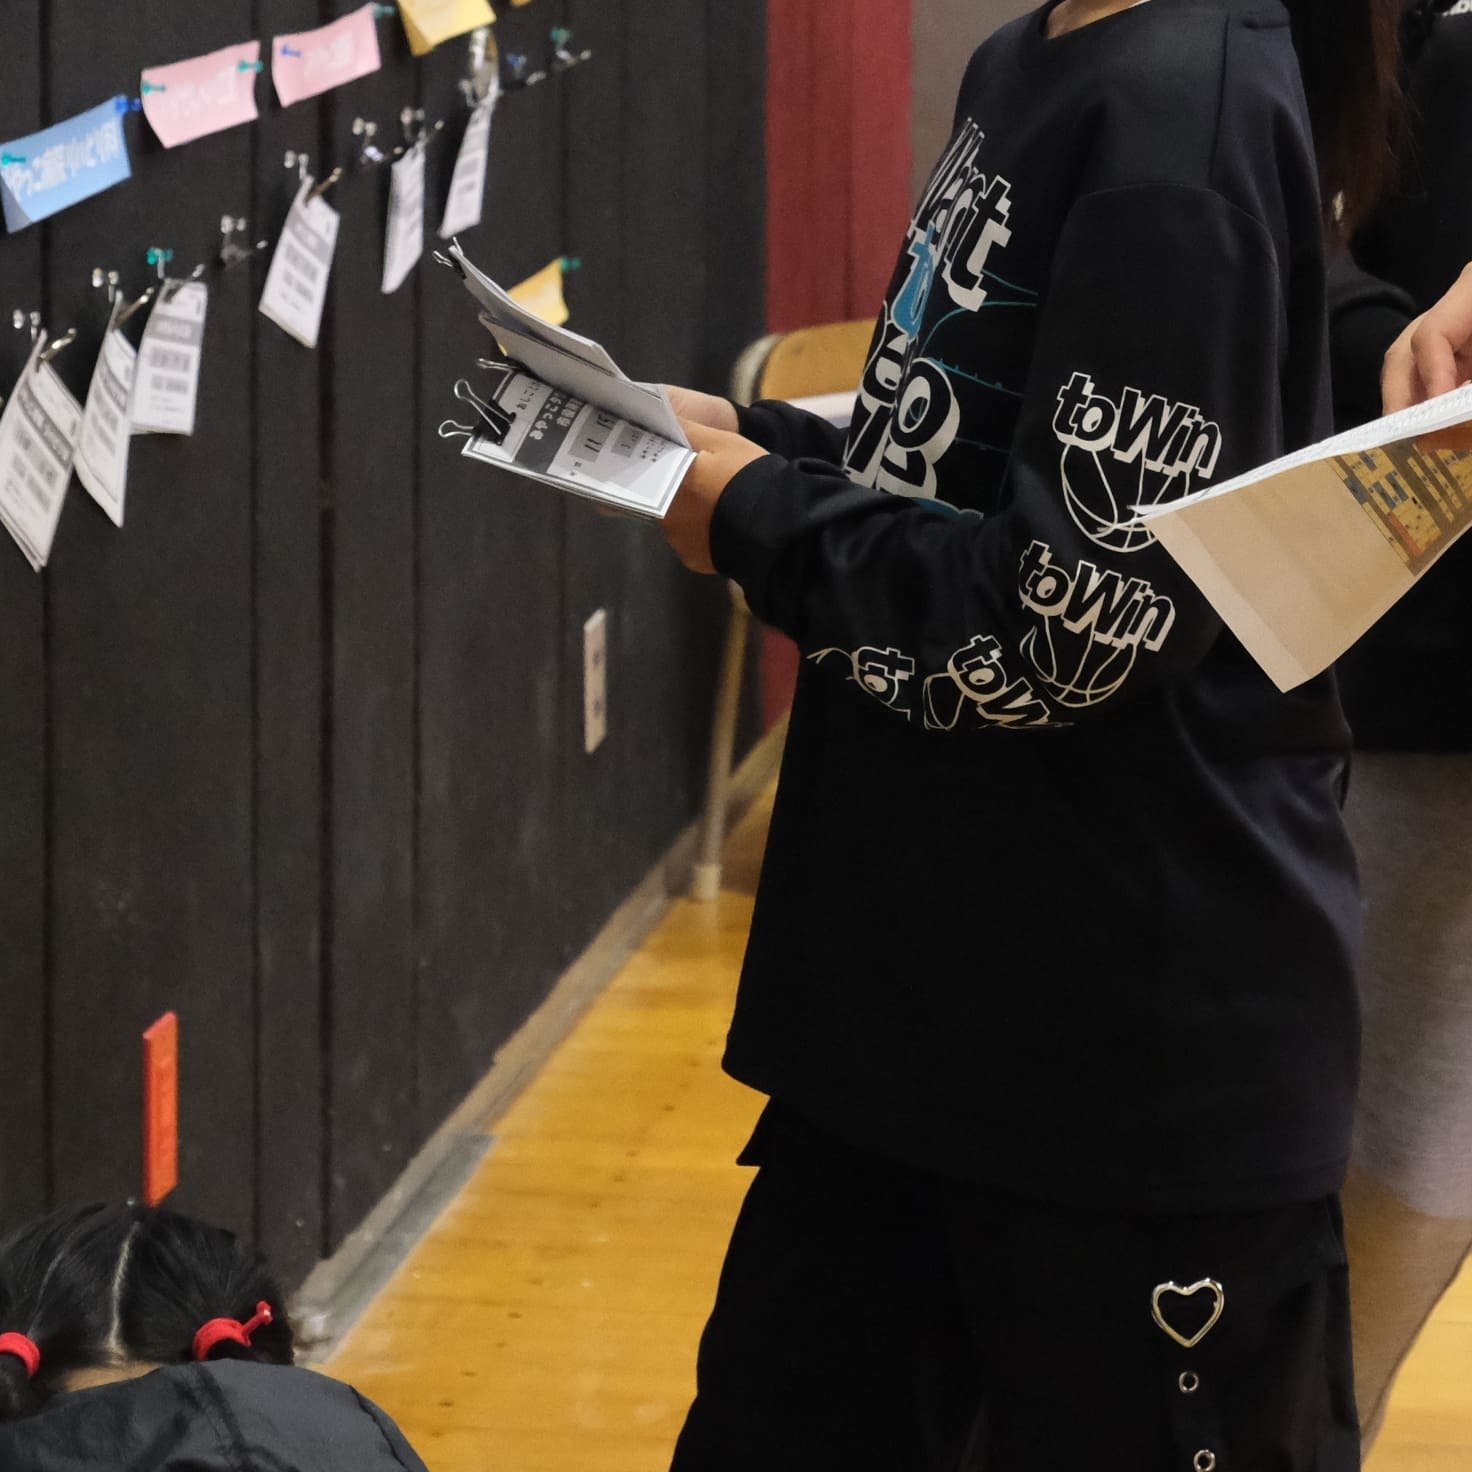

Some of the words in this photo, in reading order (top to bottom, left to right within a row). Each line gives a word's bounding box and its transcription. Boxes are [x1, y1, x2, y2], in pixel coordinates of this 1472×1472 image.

[531, 389, 568, 441] みやっこタ
[1051, 371, 1223, 480] toWin
[1018, 539, 1178, 652] toWin
